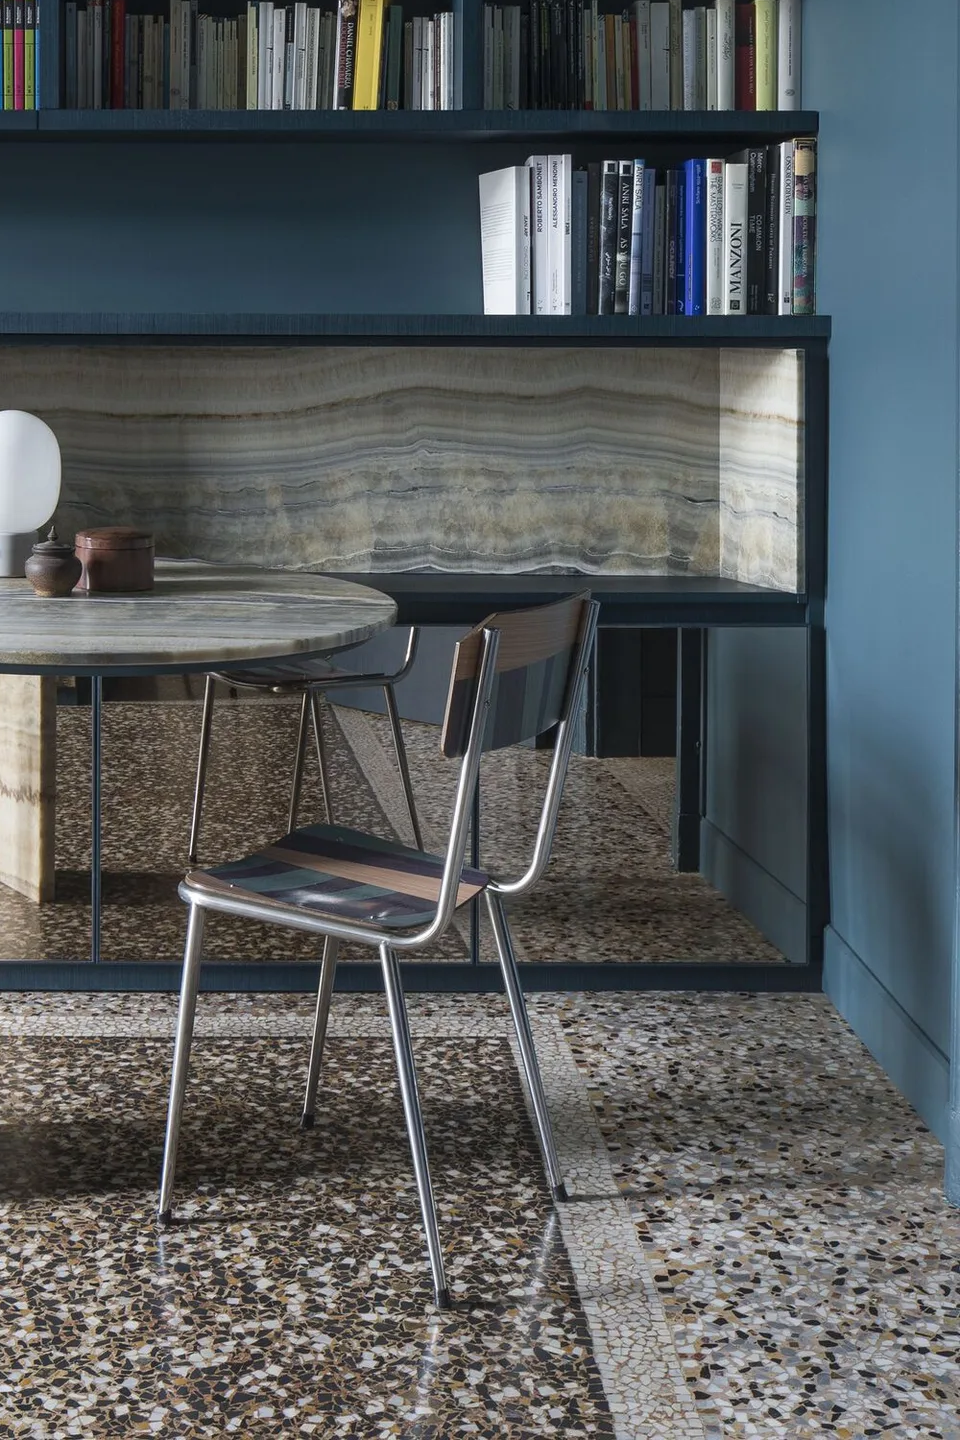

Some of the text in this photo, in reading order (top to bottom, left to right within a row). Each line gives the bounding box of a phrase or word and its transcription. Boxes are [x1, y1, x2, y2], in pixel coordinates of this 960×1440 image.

[346, 22, 354, 48] DANIEL
[635, 165, 643, 211] ANRI SALA
[748, 152, 756, 192] Cunningham
[619, 182, 630, 286] ANRI SALA AS YOU GO
[709, 192, 717, 243] MASTERWORKS
[729, 222, 742, 294] MANZONI
